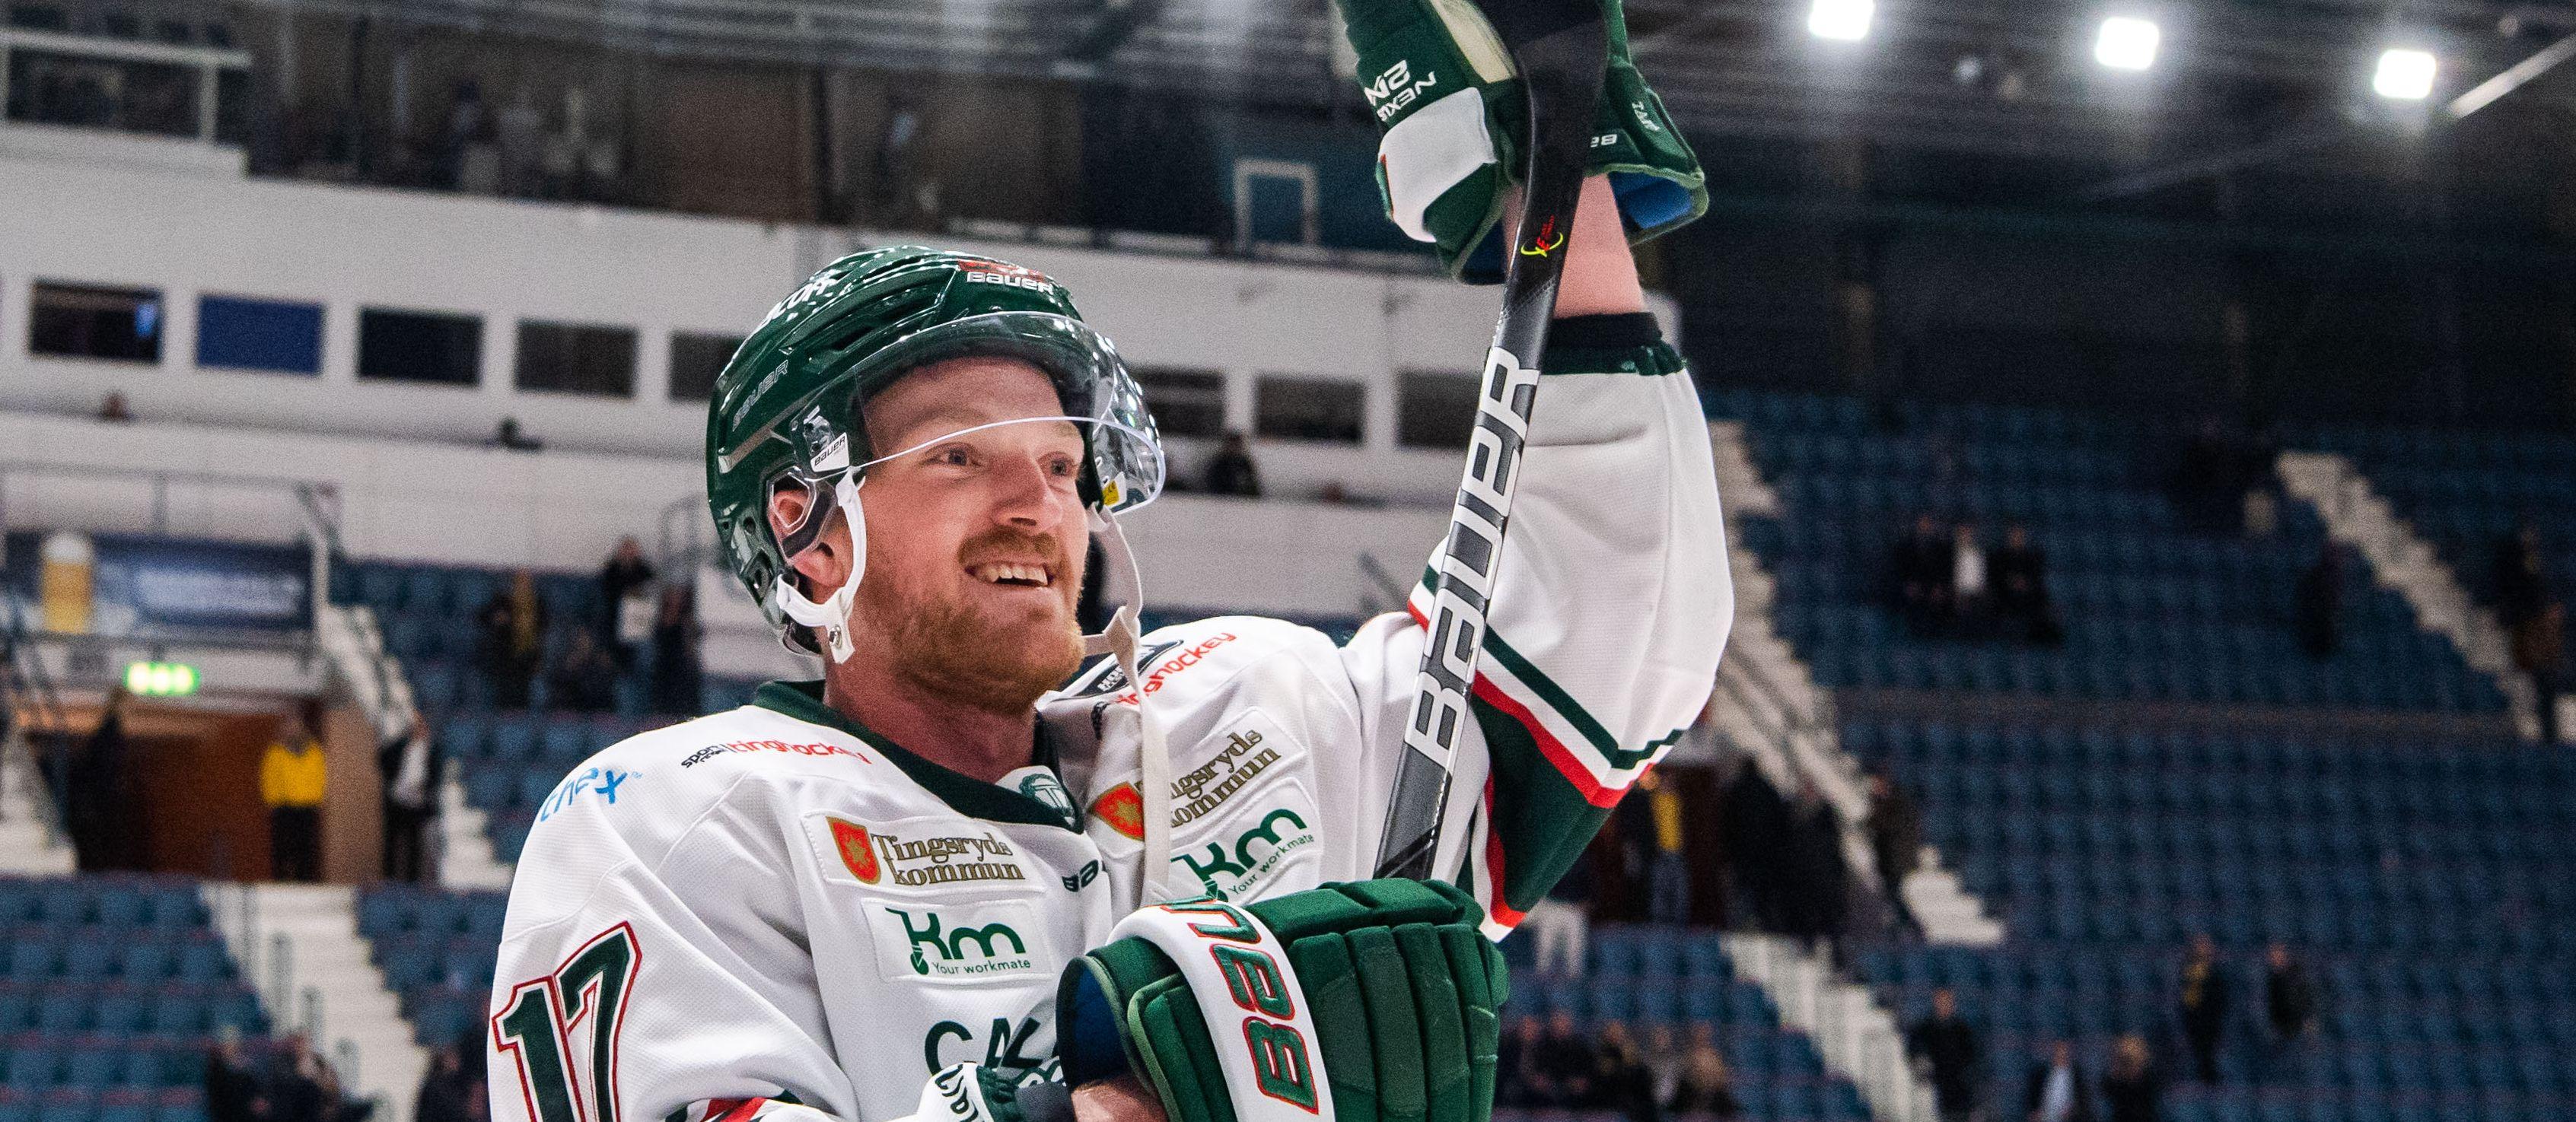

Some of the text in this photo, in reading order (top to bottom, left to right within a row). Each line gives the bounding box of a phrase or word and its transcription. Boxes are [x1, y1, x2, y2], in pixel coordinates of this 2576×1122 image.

[966, 271, 1055, 296] BAUER
[814, 435, 845, 466] BAUER
[1404, 346, 1540, 769] BAUER
[1170, 747, 1282, 828] ommun
[870, 831, 1014, 864] Tingsryds
[1228, 833, 1315, 895] Your workmate
[885, 859, 1026, 886] kommun
[931, 959, 1031, 974] Your workmate
[492, 920, 642, 1122] 17
